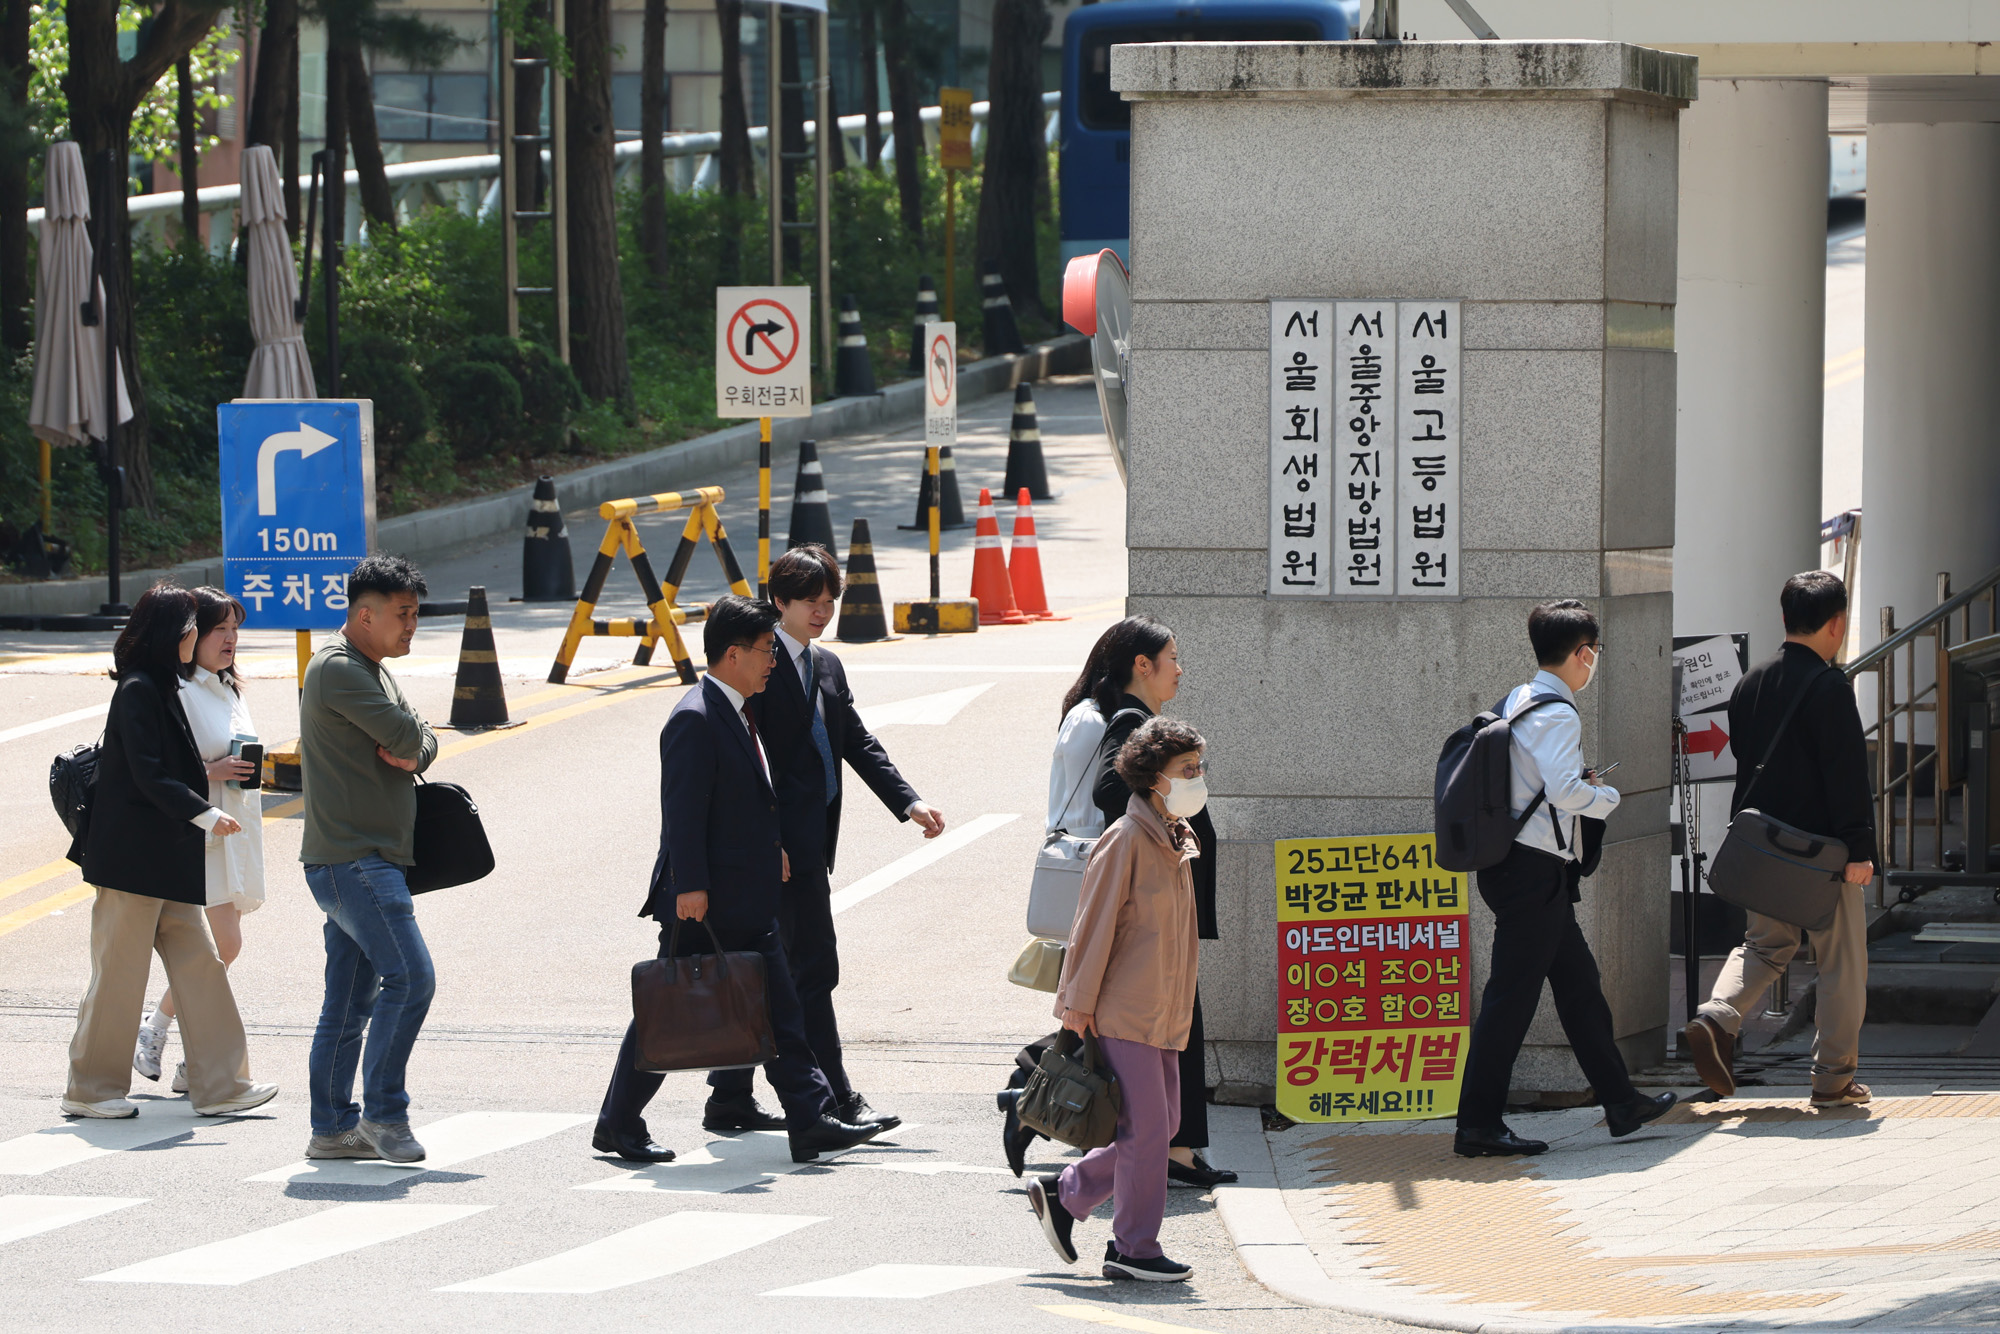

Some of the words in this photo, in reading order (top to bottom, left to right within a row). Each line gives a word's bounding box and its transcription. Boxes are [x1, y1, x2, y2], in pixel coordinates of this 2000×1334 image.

[724, 385, 804, 406] 우회전금지
[1282, 309, 1319, 586] 서울회생법원
[1348, 310, 1384, 587] 서울중앙지방법원
[1411, 309, 1447, 588] 서울고등법원
[257, 527, 338, 552] 150m
[1683, 652, 1713, 676] 원인
[1285, 881, 1368, 914] 박강균
[1376, 877, 1459, 910] 판사님
[1285, 920, 1461, 955] 아도인터네셔널
[1283, 1032, 1462, 1087] 강력처벌
[1308, 1088, 1435, 1117] 해주세요!!!
